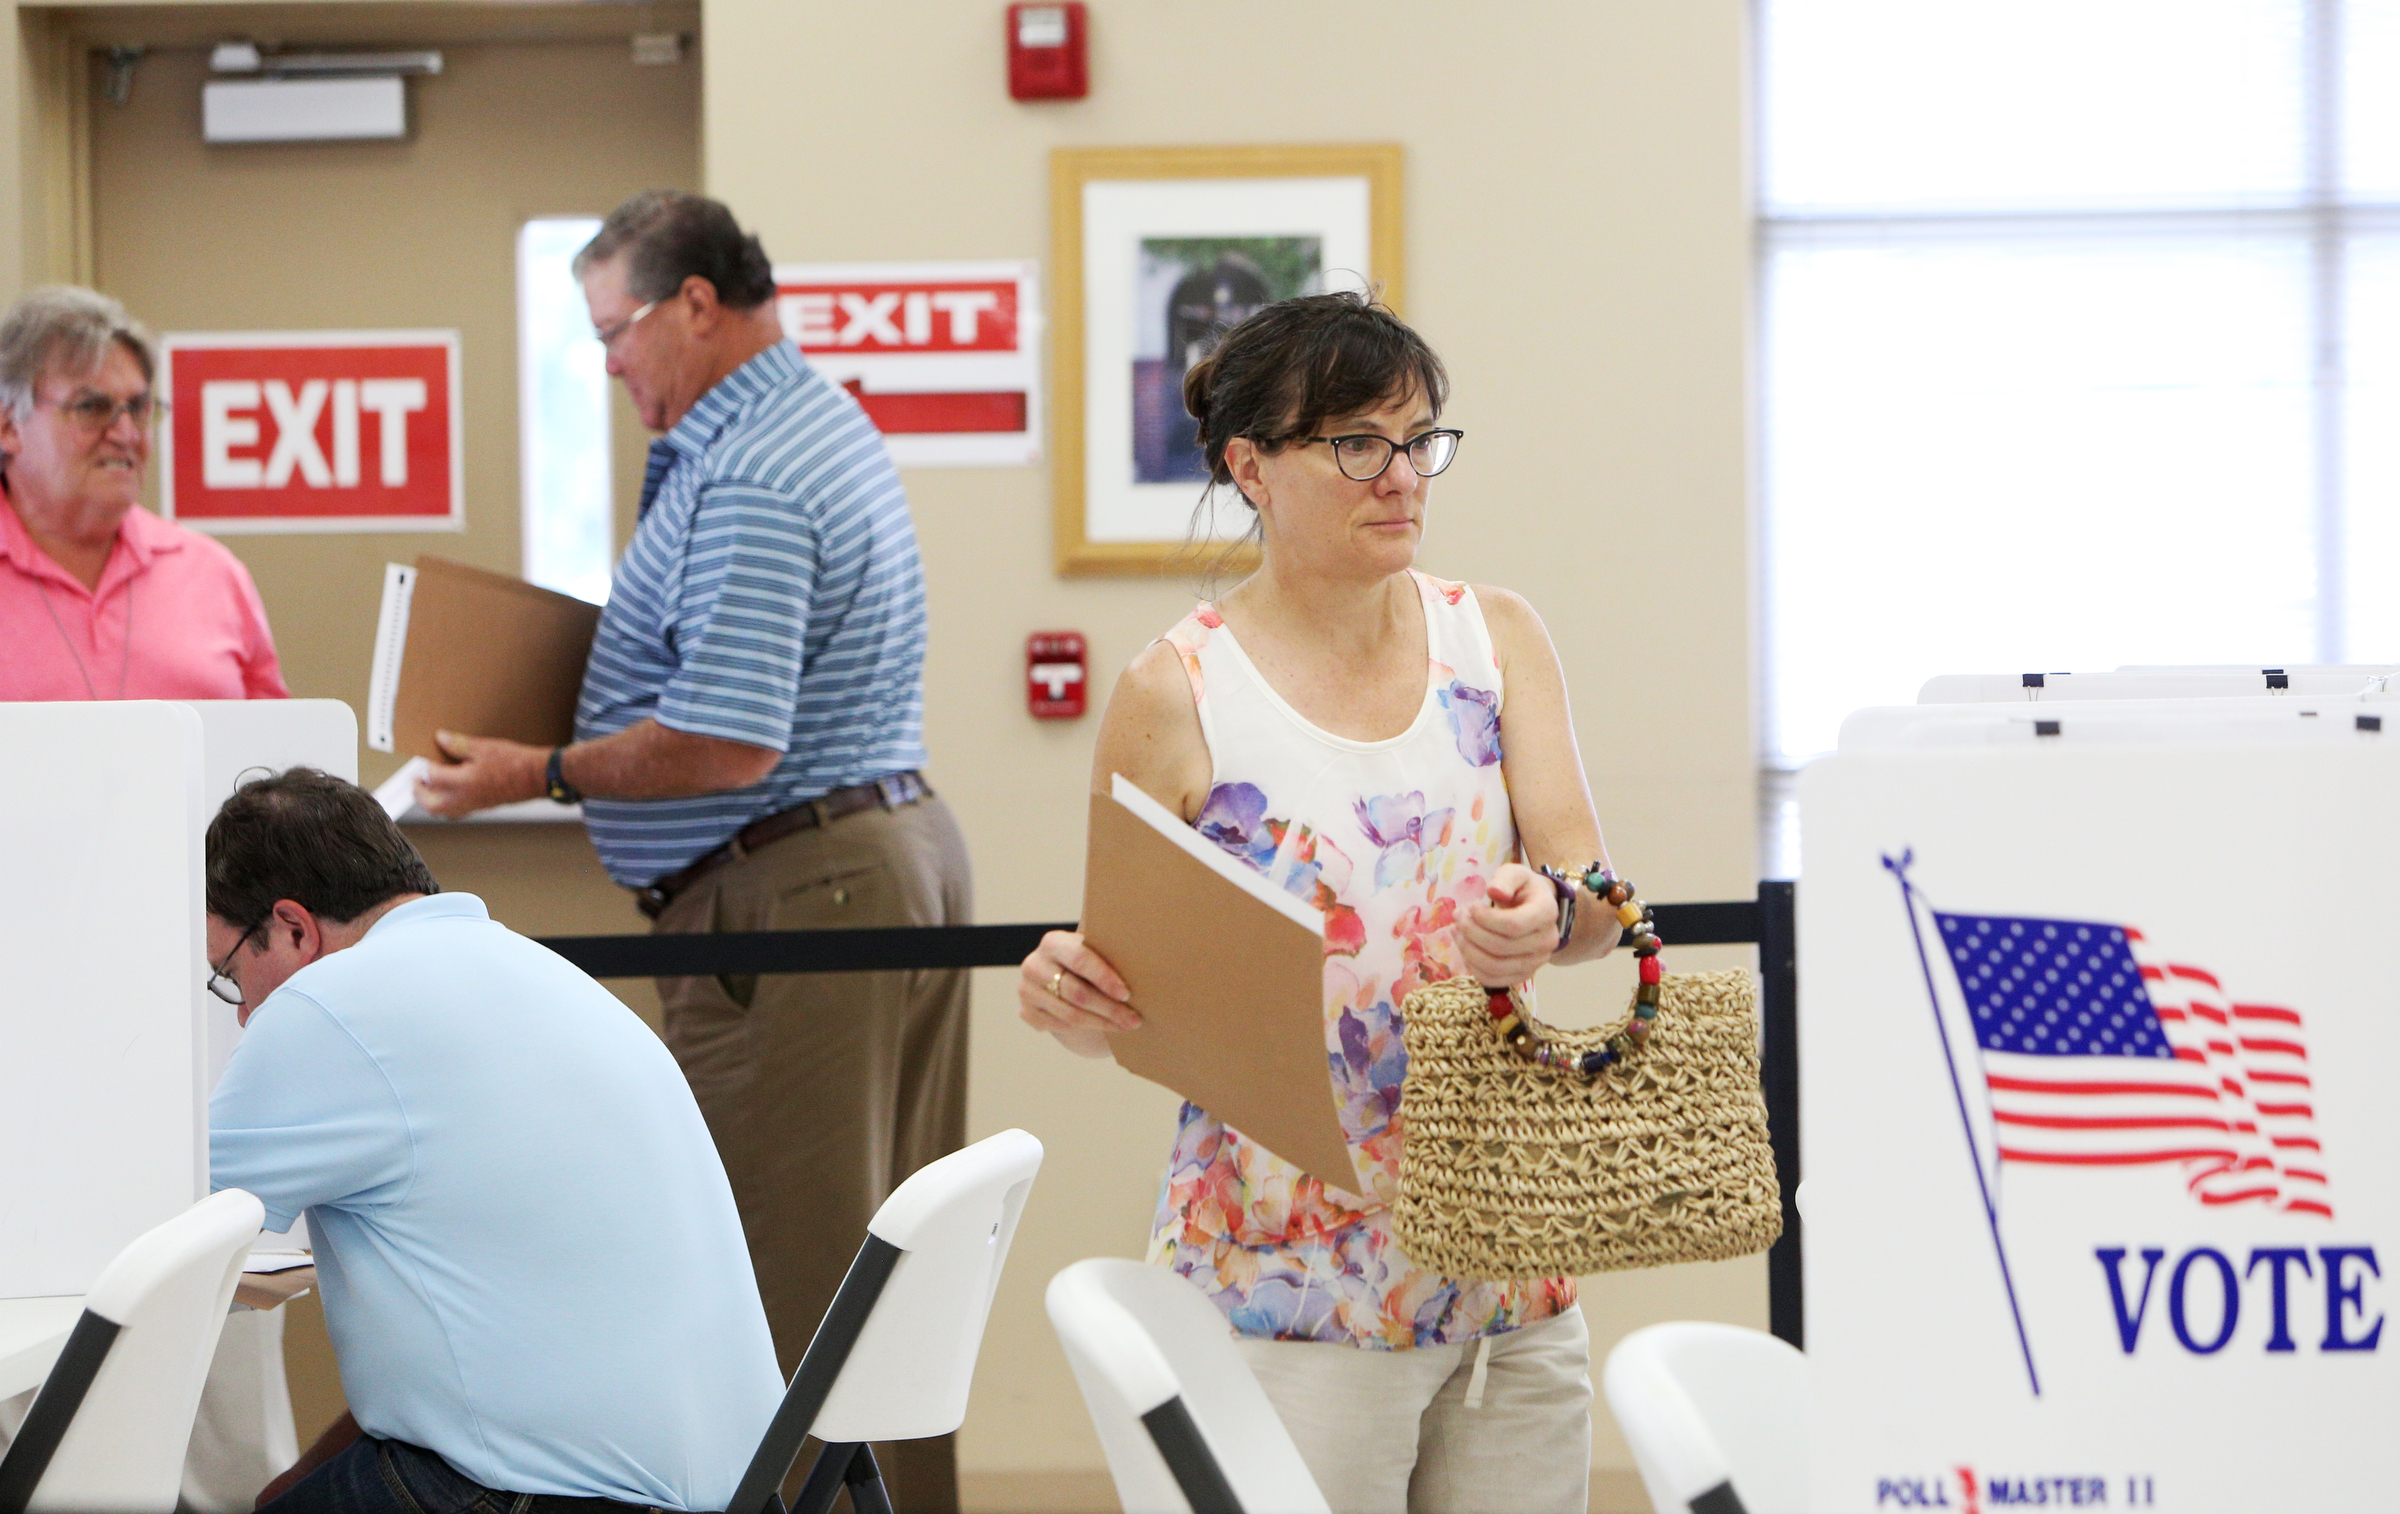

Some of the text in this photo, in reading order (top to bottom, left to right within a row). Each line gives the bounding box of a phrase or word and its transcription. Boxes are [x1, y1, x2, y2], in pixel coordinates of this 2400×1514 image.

[778, 290, 998, 347] EXIT
[202, 378, 427, 488] EXIT
[2094, 1246, 2384, 1355] VOTE
[1876, 1477, 1949, 1507] POLL
[1988, 1475, 2109, 1505] MASTER
